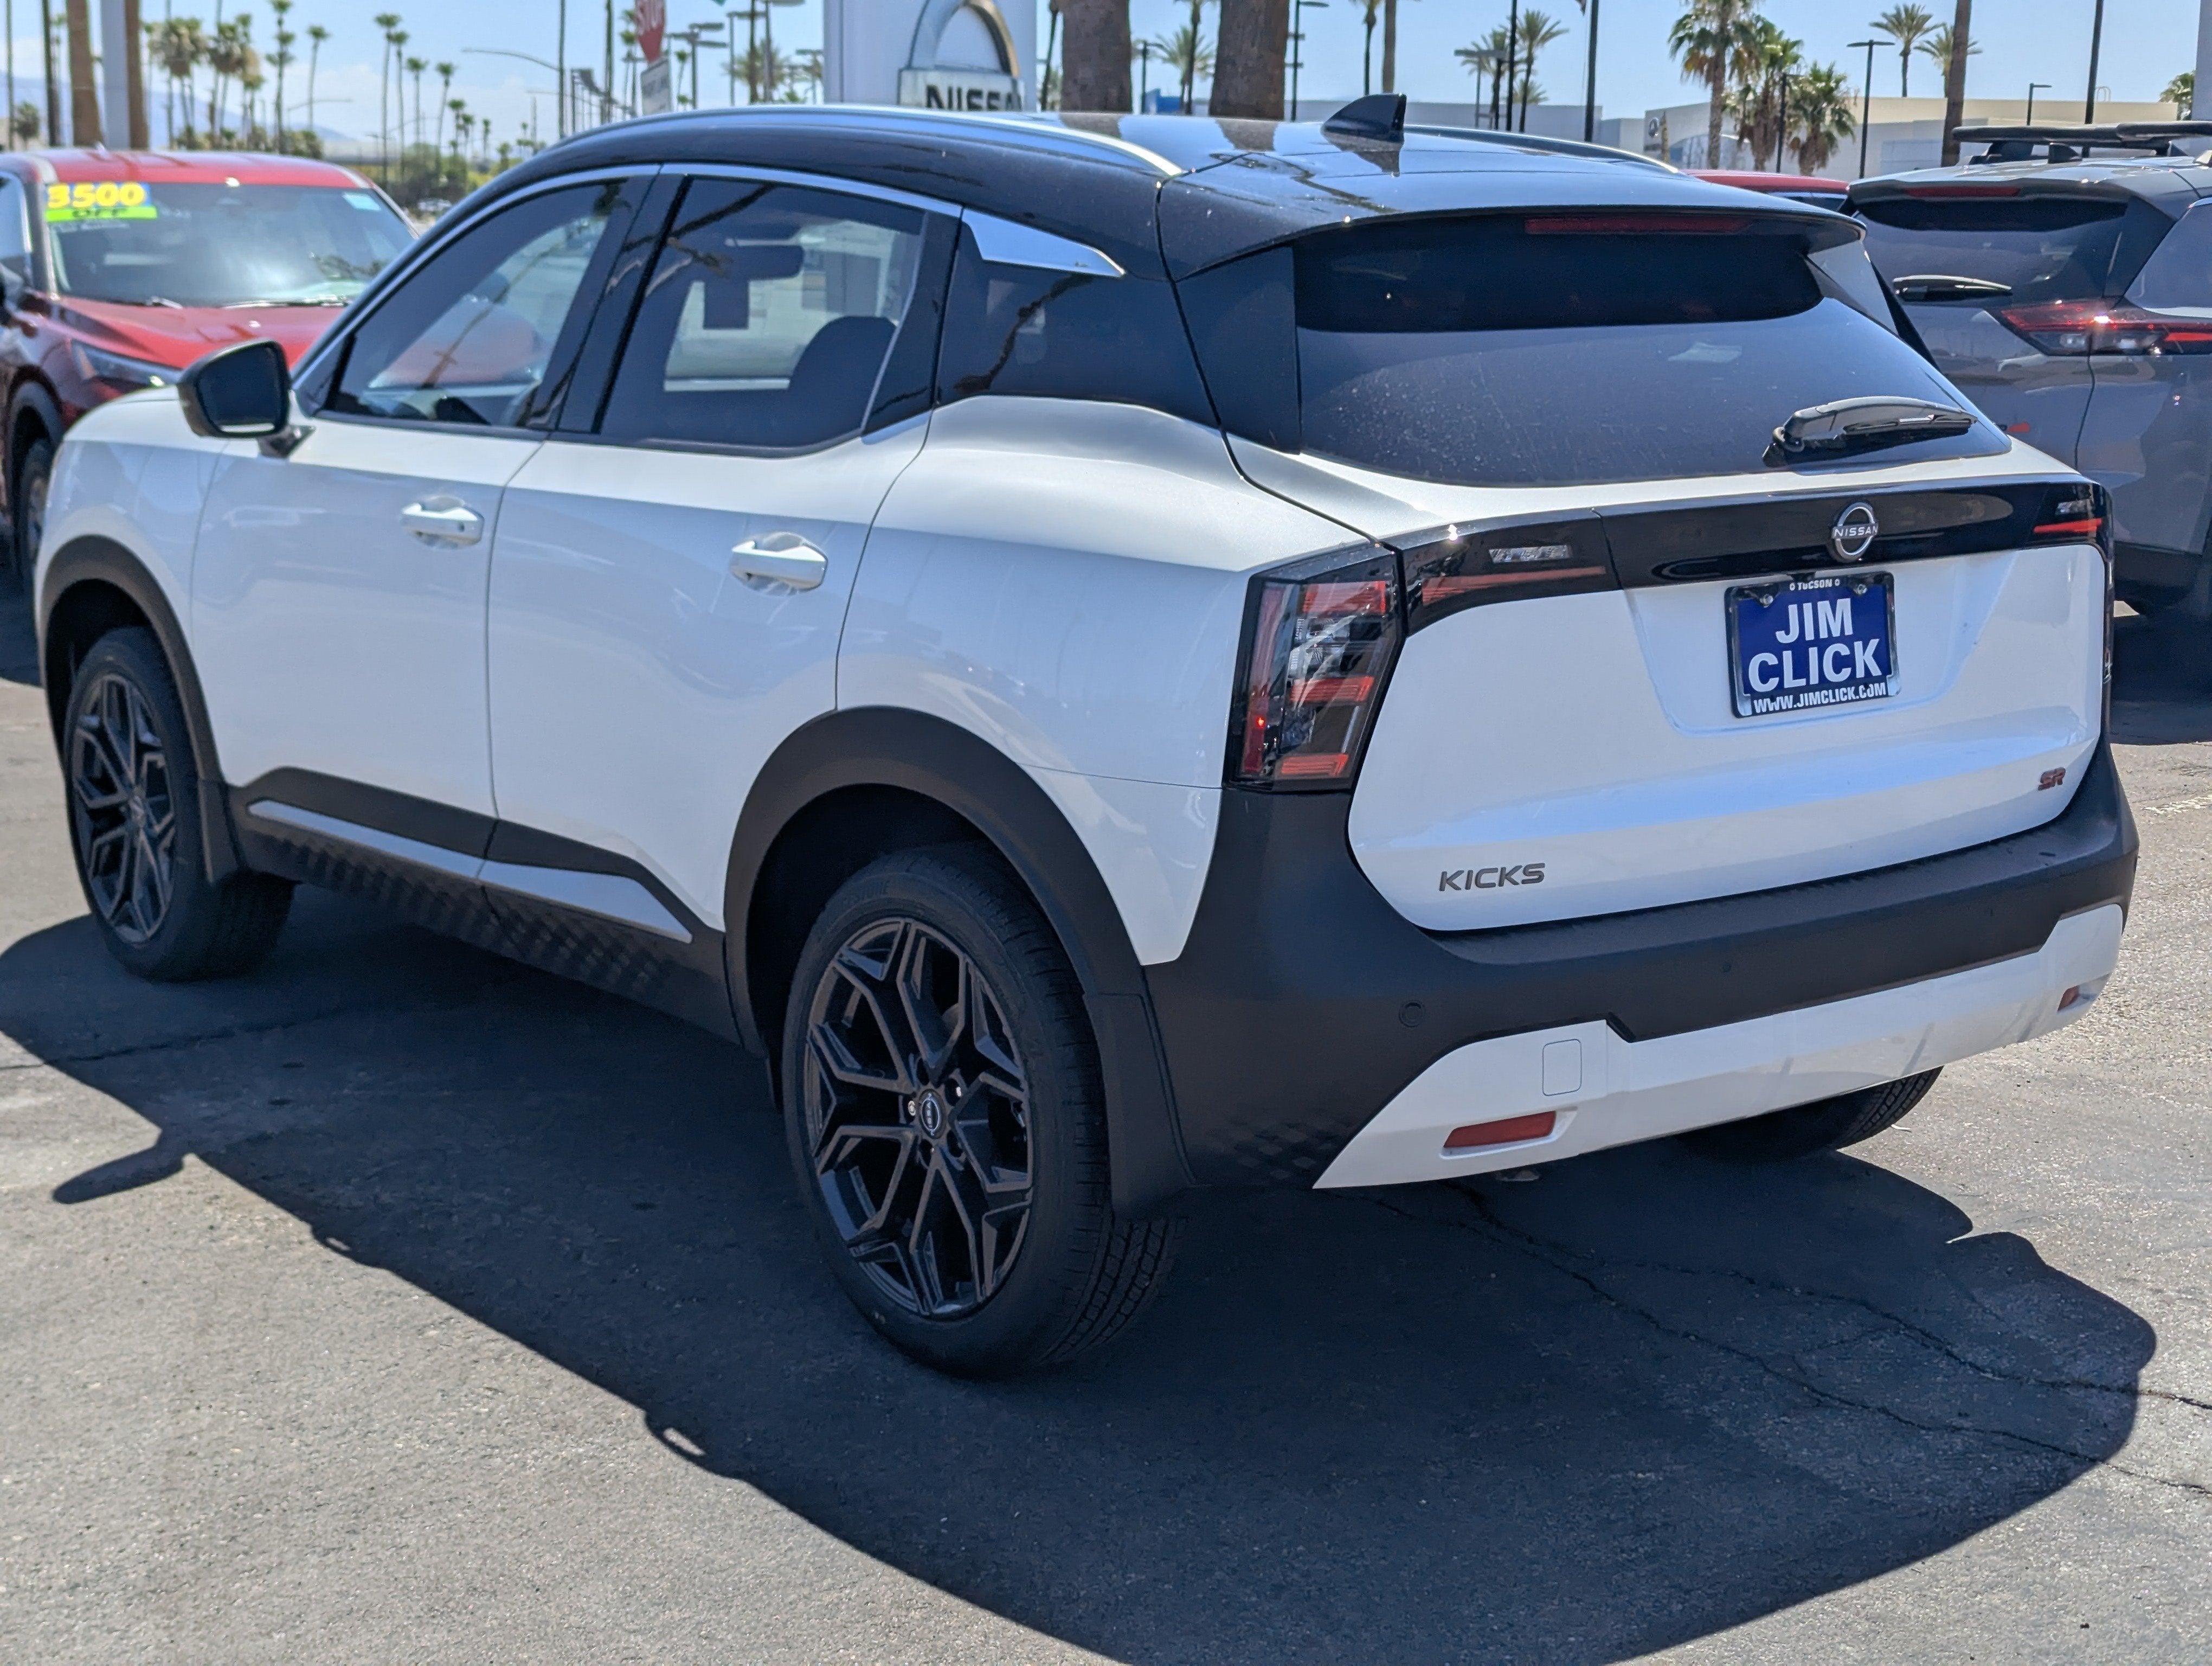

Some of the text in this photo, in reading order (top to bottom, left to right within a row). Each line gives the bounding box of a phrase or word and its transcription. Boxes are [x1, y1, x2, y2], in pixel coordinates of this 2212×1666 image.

[926, 85, 1023, 110] NISSA
[48, 182, 145, 208] 3500
[1834, 526, 1878, 537] NISSAN
[1797, 579, 1832, 591] TUCSON
[1775, 598, 1854, 644] JIM
[1748, 638, 1882, 693] CLICK
[1753, 682, 1887, 714] WWW.JIMCLICK.COM
[2037, 766, 2066, 791] SR
[1439, 862, 1546, 892] KICKS
